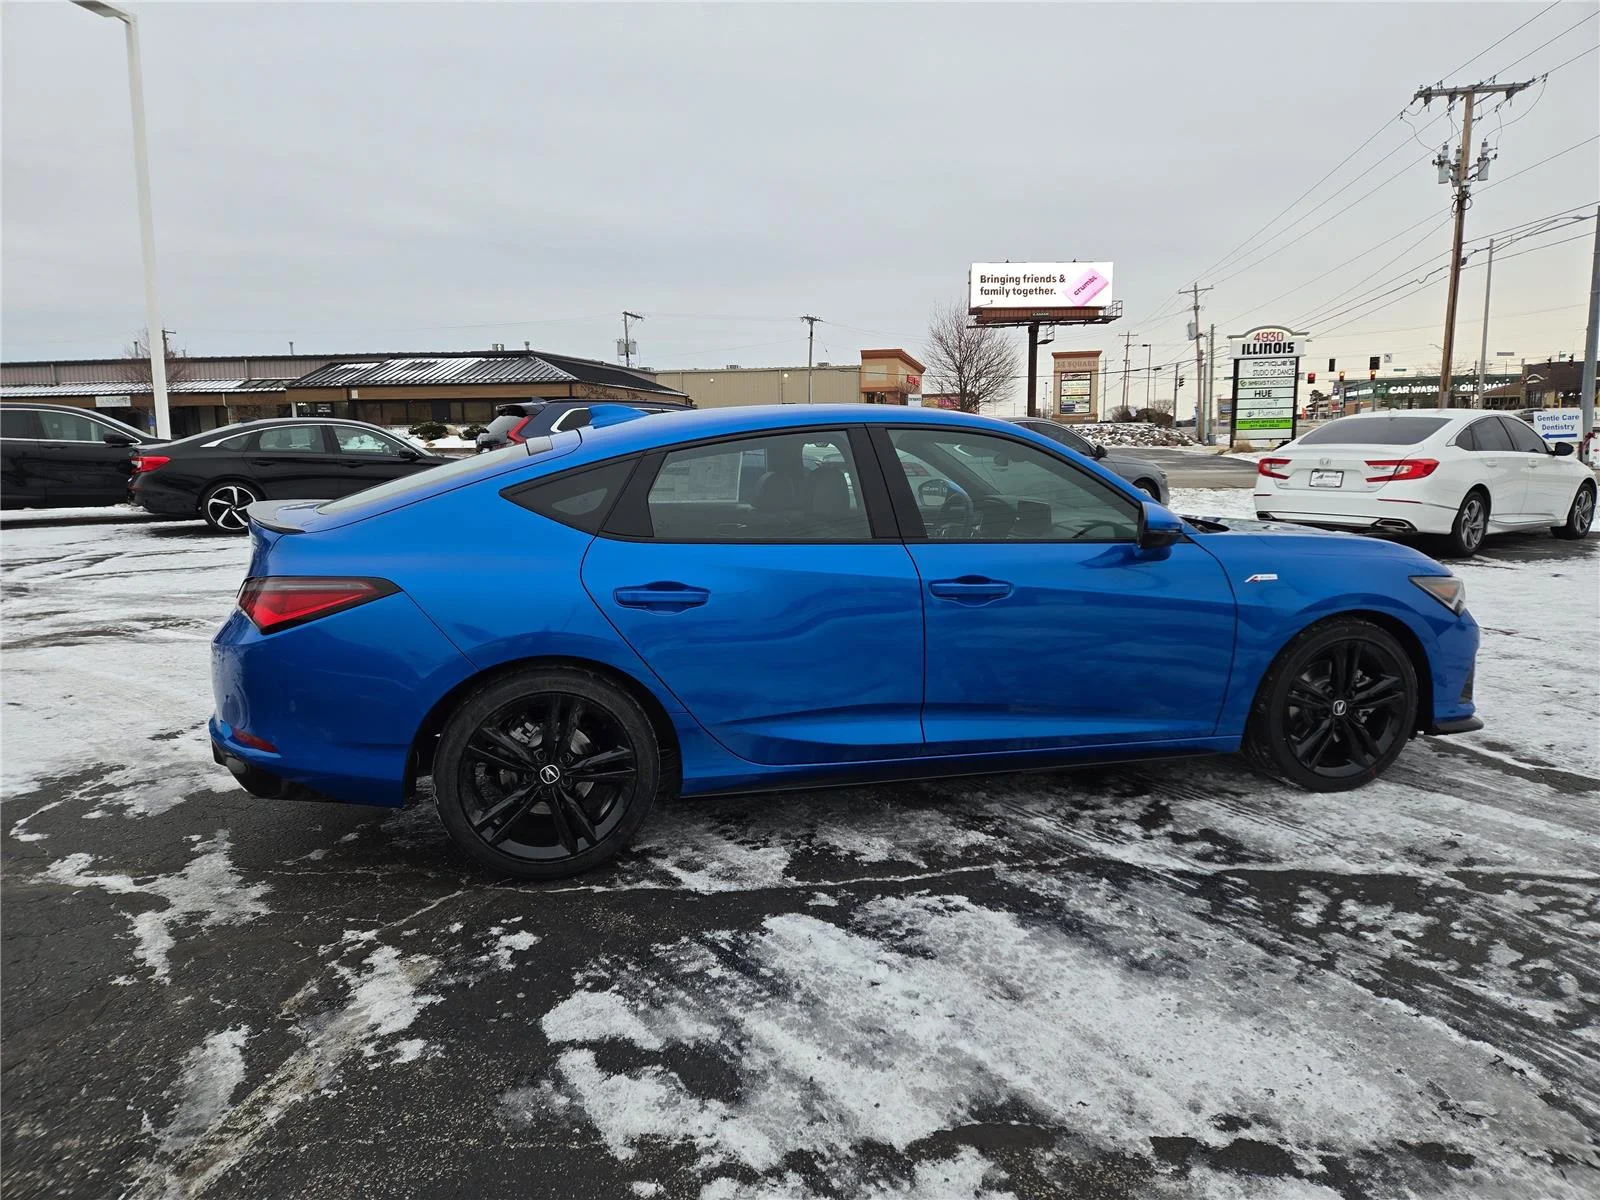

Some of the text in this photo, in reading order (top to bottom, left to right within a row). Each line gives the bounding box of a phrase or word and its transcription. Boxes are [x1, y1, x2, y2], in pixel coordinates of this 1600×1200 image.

[980, 274, 1066, 285] Bringing friends &
[980, 286, 1057, 297] family together.
[1254, 331, 1284, 342] 4930
[1241, 342, 1295, 355] ILLINOIS
[1277, 368, 1294, 376] DANCE
[1254, 389, 1273, 397] HUE
[1388, 386, 1410, 394] CAR
[1411, 385, 1440, 393] WASH
